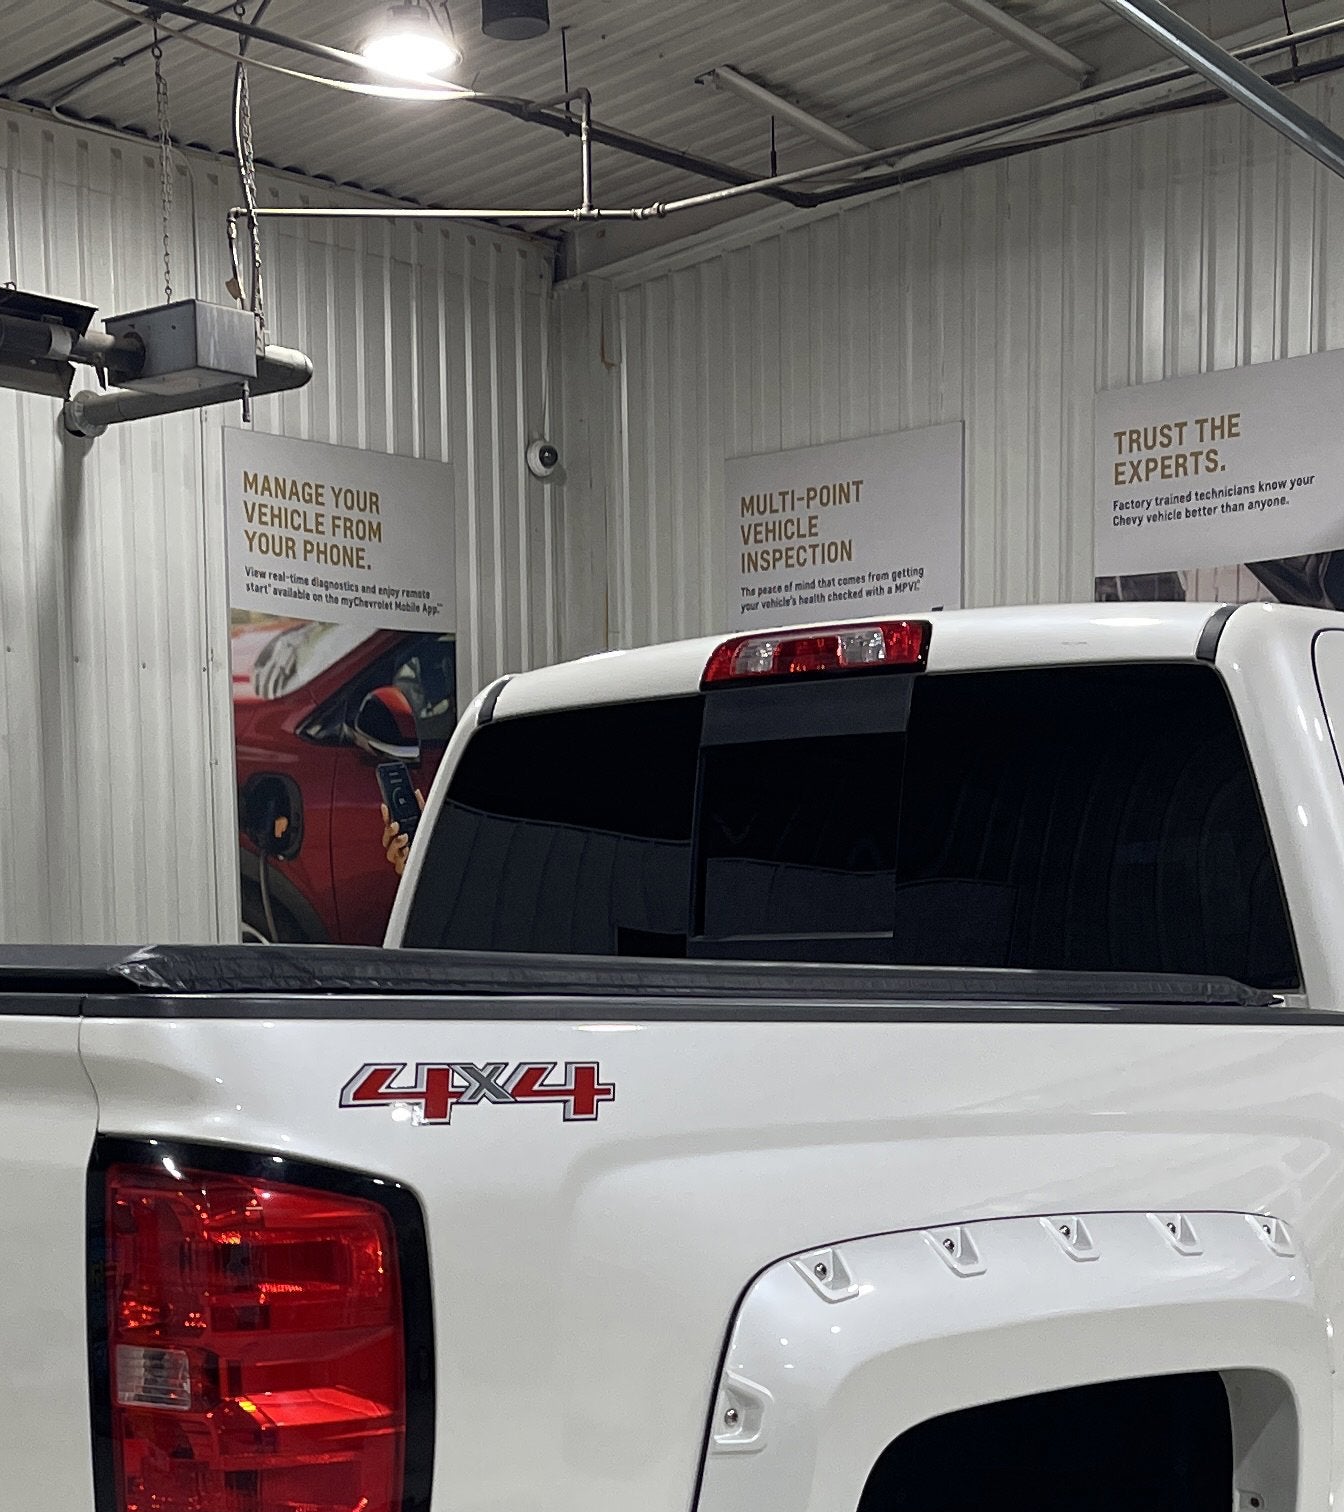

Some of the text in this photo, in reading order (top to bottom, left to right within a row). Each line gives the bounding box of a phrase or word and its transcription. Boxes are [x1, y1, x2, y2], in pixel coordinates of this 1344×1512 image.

[1113, 412, 1240, 455] TRUST THE
[1114, 448, 1225, 485] EXPERTS.
[243, 470, 380, 515] MANAGE YOUR
[741, 479, 863, 518] MULTI-POINT
[1113, 475, 1315, 511] Factory trained technicians know your
[243, 500, 381, 543] VEHICLE FROM
[1113, 496, 1289, 526] Chevy vehicle better than anyone.
[740, 515, 818, 545] VEHICLE
[244, 529, 371, 570] YOUR PHONE.
[741, 538, 852, 574] INSPECTION
[244, 565, 430, 599] View real-time diagnostics and enjoy remote
[272, 587, 310, 600] available
[312, 593, 323, 602] on
[324, 593, 339, 604] the
[341, 596, 392, 610] myChevrolet
[394, 600, 420, 612] Mobile
[740, 567, 924, 597] The peace of mind that comes from getting
[740, 601, 759, 614] your
[761, 595, 796, 608] vehicle's
[798, 592, 825, 605] health
[827, 587, 863, 602] checked
[865, 584, 884, 597] with
[887, 586, 892, 594] a
